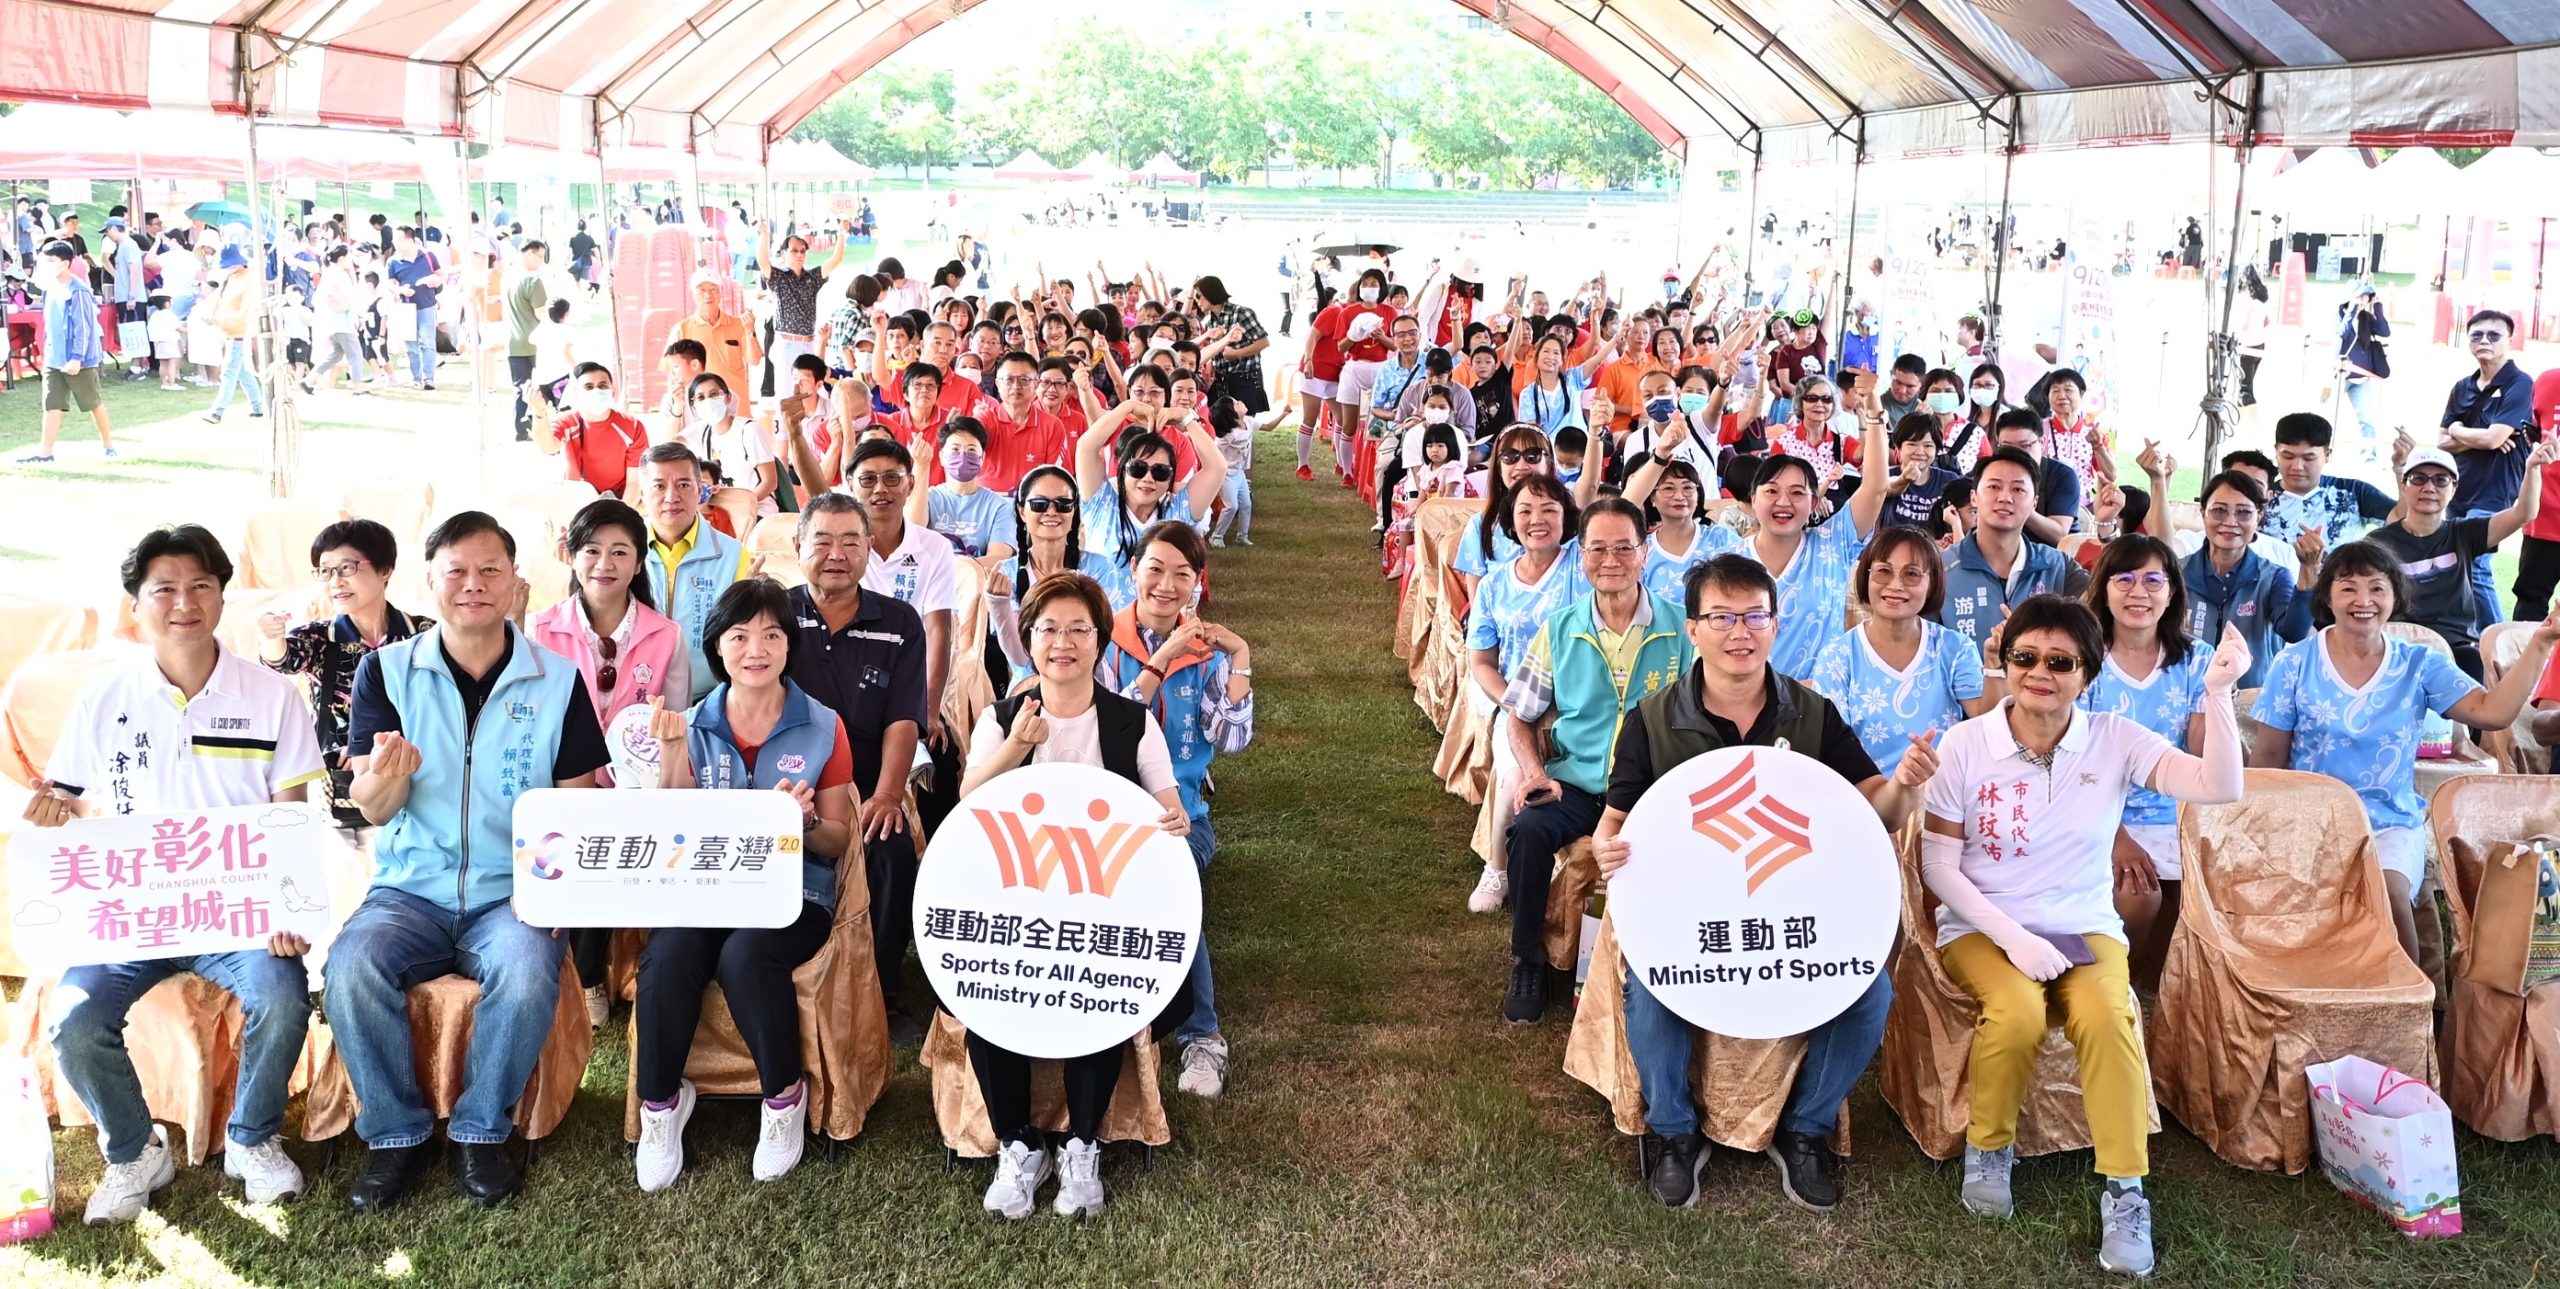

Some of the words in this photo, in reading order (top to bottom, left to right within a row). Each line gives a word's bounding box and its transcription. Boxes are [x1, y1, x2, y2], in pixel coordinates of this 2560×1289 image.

[135, 732, 151, 768] 議員
[519, 733, 534, 788] 代理市長
[501, 748, 517, 796] 賴致富
[50, 816, 267, 894] 美好彰化
[780, 838, 799, 851] 2.0
[149, 877, 216, 890] CHANGHUA
[221, 873, 269, 884] COUNTY
[87, 890, 271, 948] 希望城市
[924, 907, 1186, 964] 運動部全民運動署
[1698, 916, 1818, 954] 運動部
[941, 953, 1010, 975] Sports
[1014, 960, 1044, 979] for
[1047, 964, 1075, 982] All
[1078, 967, 1160, 995] Agency,
[1649, 964, 1752, 986] Ministry
[1758, 959, 1784, 980] of
[1789, 957, 1875, 982] Sports
[956, 981, 1041, 1009] Ministry
[1044, 990, 1067, 1006] of
[1069, 993, 1140, 1016] Sports
